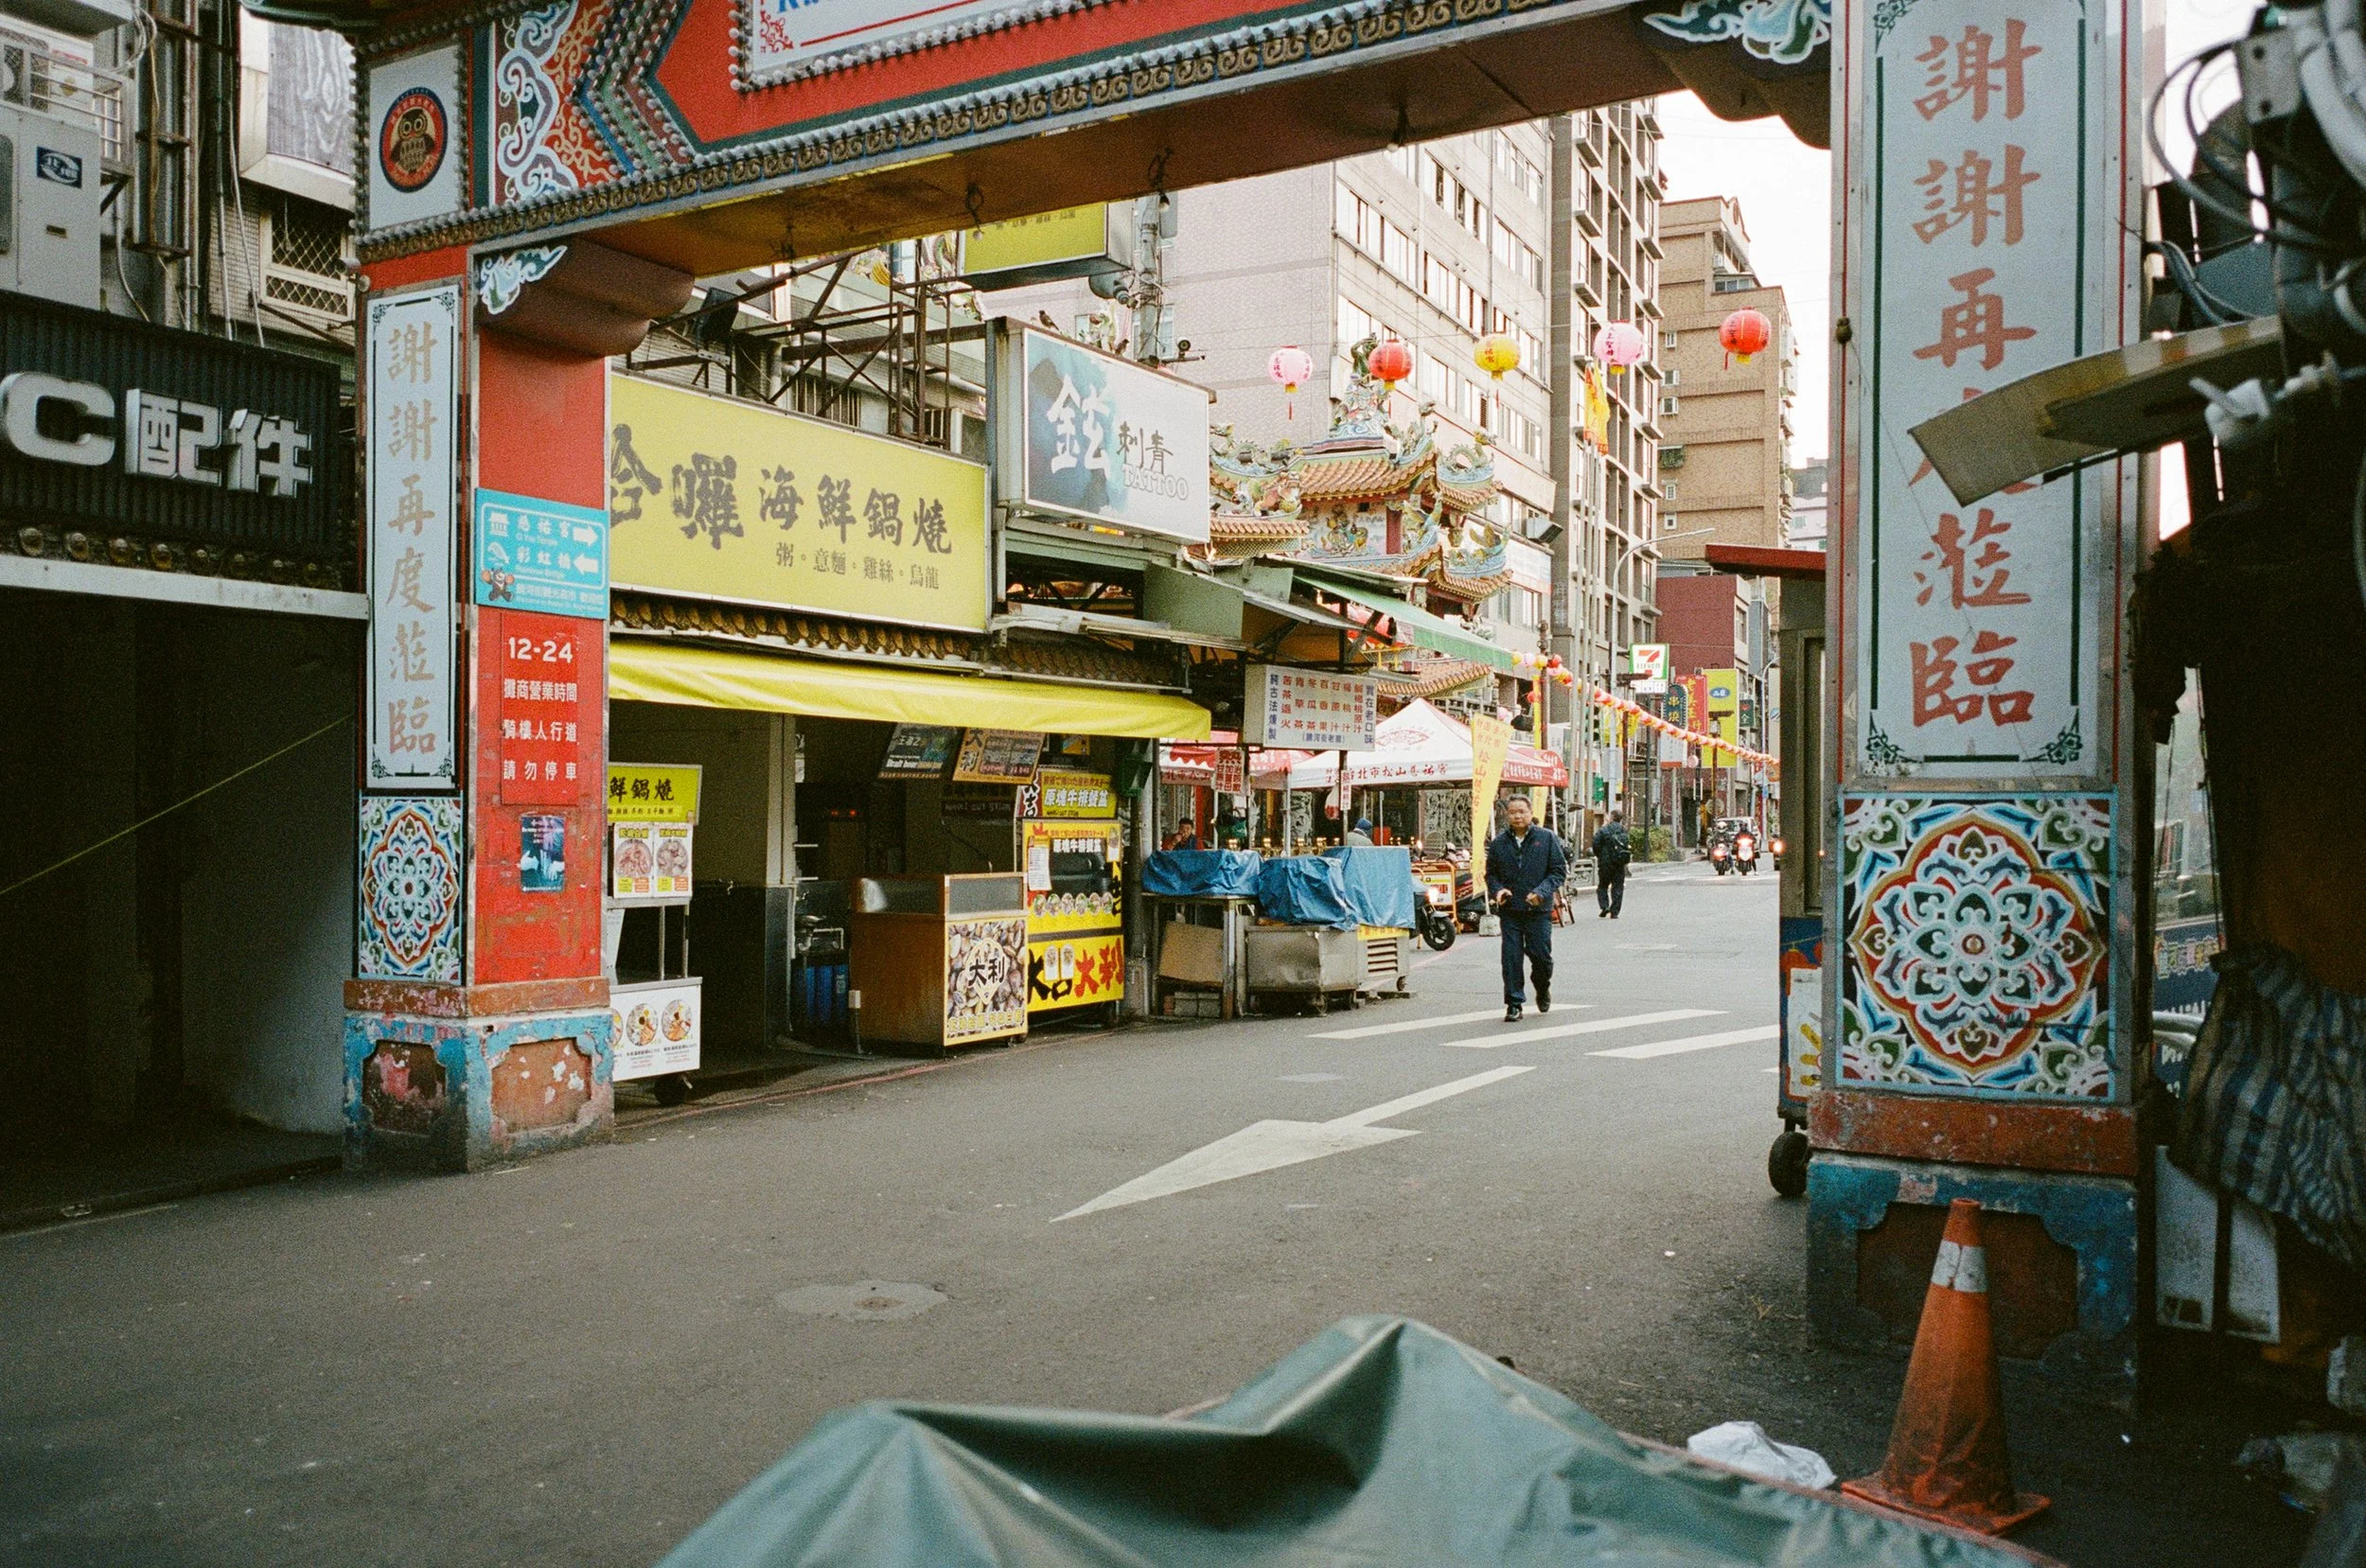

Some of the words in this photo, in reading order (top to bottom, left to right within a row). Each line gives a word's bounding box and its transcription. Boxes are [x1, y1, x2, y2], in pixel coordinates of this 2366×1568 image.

[1908, 18, 2042, 728] 謝謝再蒞臨
[1117, 421, 1174, 474] 刺青
[1121, 463, 1189, 501] TATTOO
[385, 320, 437, 757] 謝謝再度蒞臨
[508, 637, 574, 664] 12-24
[503, 678, 577, 702] 攤商營業時間
[503, 719, 577, 743] 騎樓人行道
[503, 760, 577, 781] 請勿停車
[967, 957, 1005, 988] 大利
